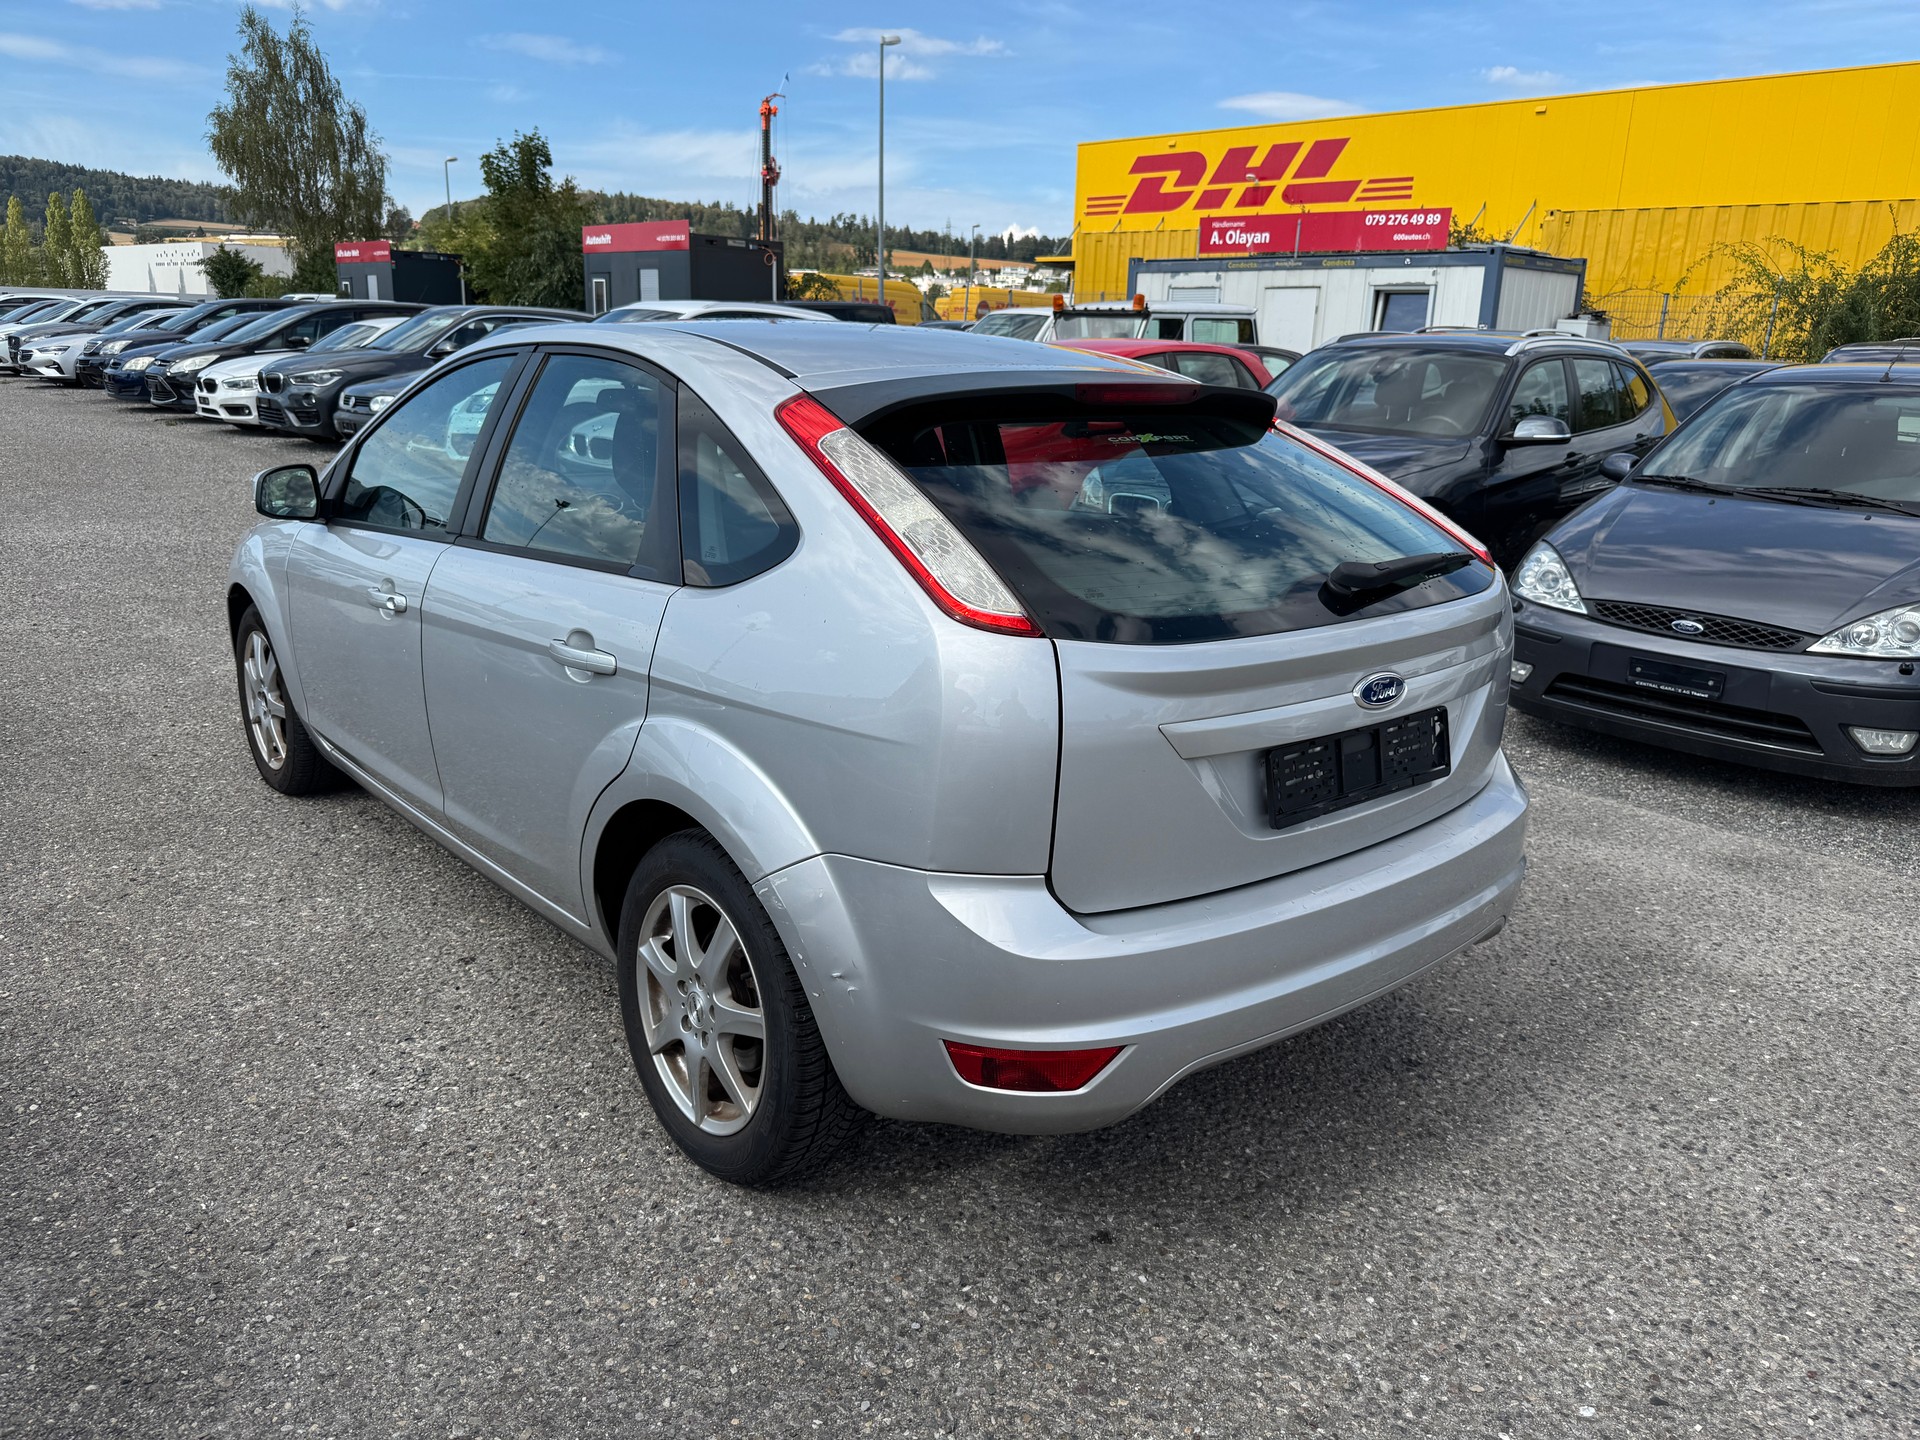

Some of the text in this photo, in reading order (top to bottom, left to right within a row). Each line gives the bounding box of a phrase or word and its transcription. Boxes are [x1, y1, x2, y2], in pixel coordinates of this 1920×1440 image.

[1122, 137, 1362, 214] DHL
[1365, 213, 1442, 226] 079 276 49 89
[585, 233, 612, 245] Autoshift
[1209, 229, 1270, 248] A. Olayan
[1393, 233, 1431, 241] 600autos.ch
[1370, 678, 1397, 701] Ford
